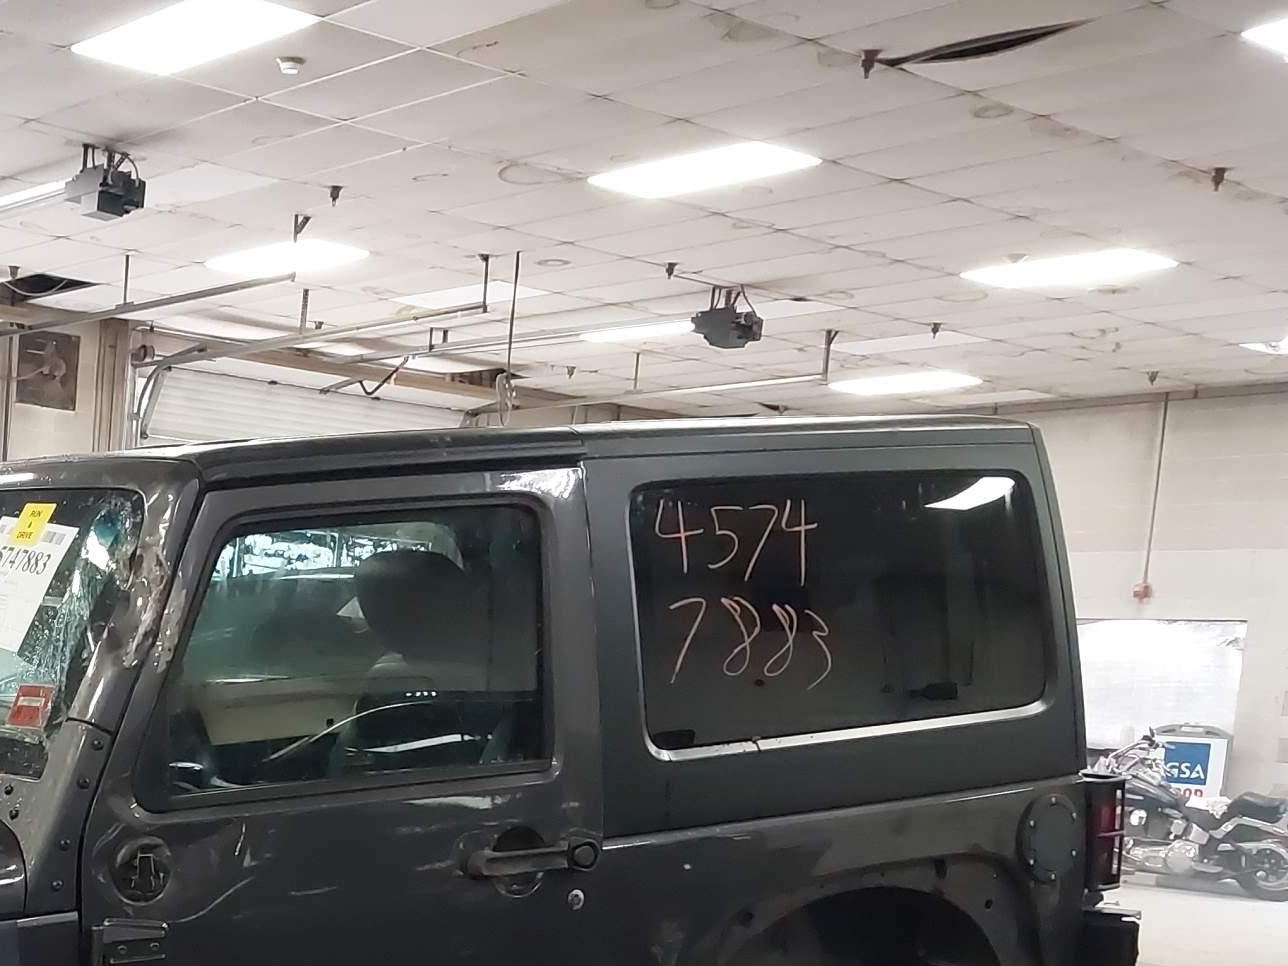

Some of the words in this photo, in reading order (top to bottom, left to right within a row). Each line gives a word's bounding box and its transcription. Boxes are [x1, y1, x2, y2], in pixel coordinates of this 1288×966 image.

[655, 499, 818, 587] 4574
[669, 596, 832, 690] 7883
[1166, 762, 1205, 779] GSA
